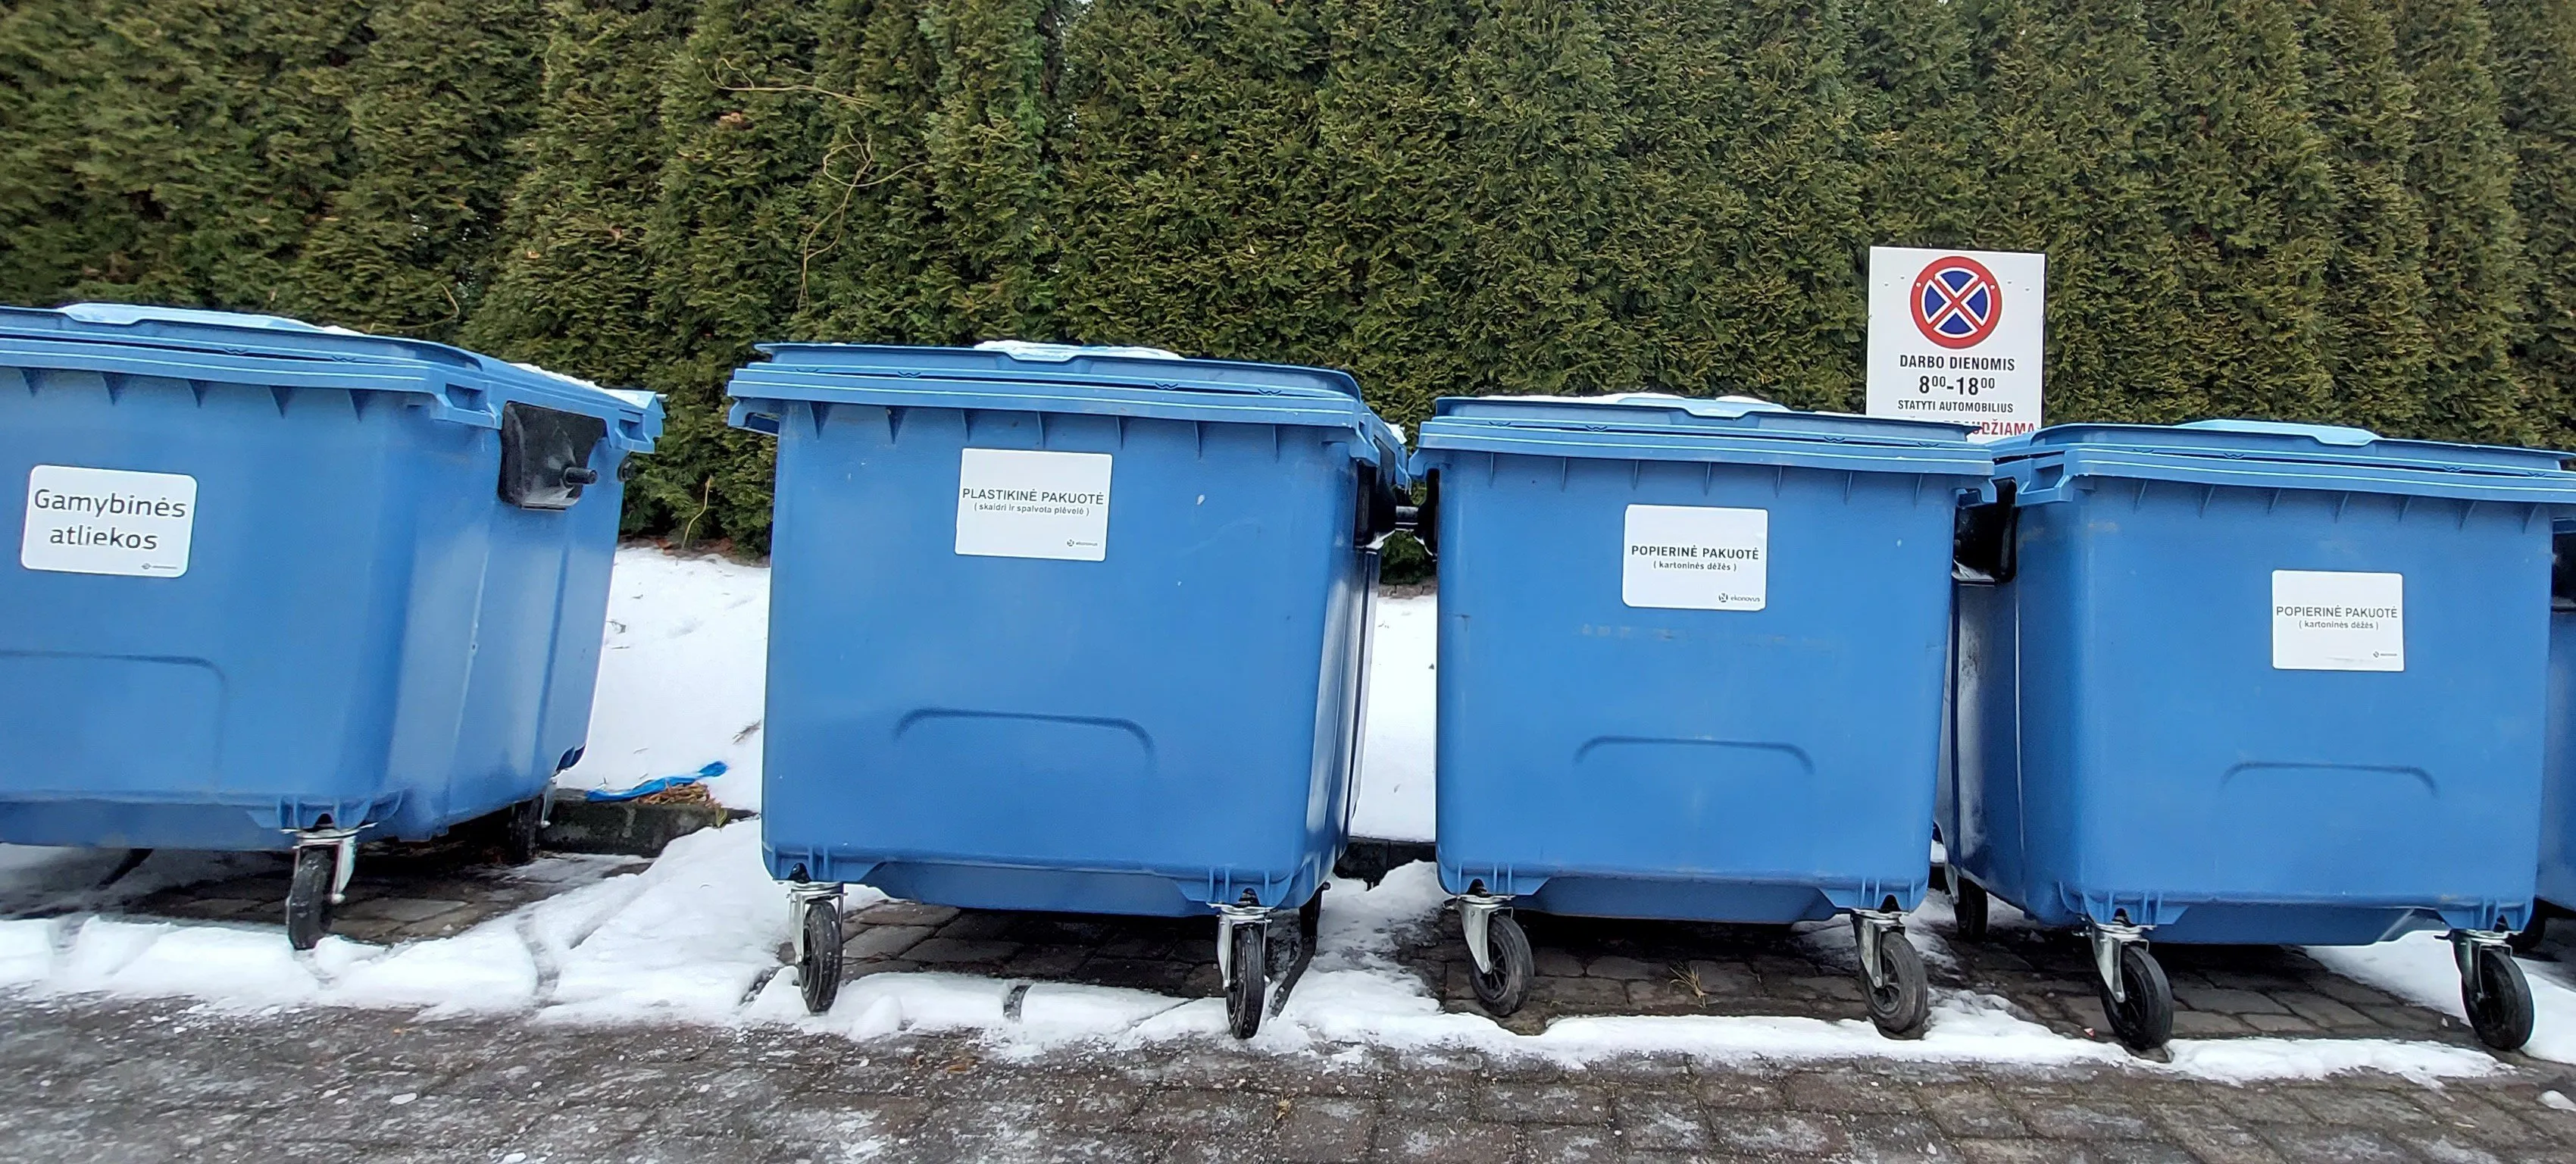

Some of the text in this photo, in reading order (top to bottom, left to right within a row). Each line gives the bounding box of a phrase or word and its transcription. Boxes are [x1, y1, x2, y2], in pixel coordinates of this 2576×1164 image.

[1899, 354, 2015, 371] DARBO DIENOMIS
[1897, 399, 2014, 414] STATYTI AUTOMOBILIUS
[34, 488, 187, 518] Gamybinės
[962, 487, 1105, 505] PLASTIKINĖ PAKUOTĖ
[49, 524, 158, 550] atliekos
[1631, 544, 1759, 560] POPIERINĖ PAKUOTĖ
[1658, 561, 1705, 570] kartoninės
[1707, 562, 1731, 571] dėžės
[2276, 604, 2398, 618] POPIERINĖ PAKUOTĖ
[2304, 620, 2349, 629] kartoninės
